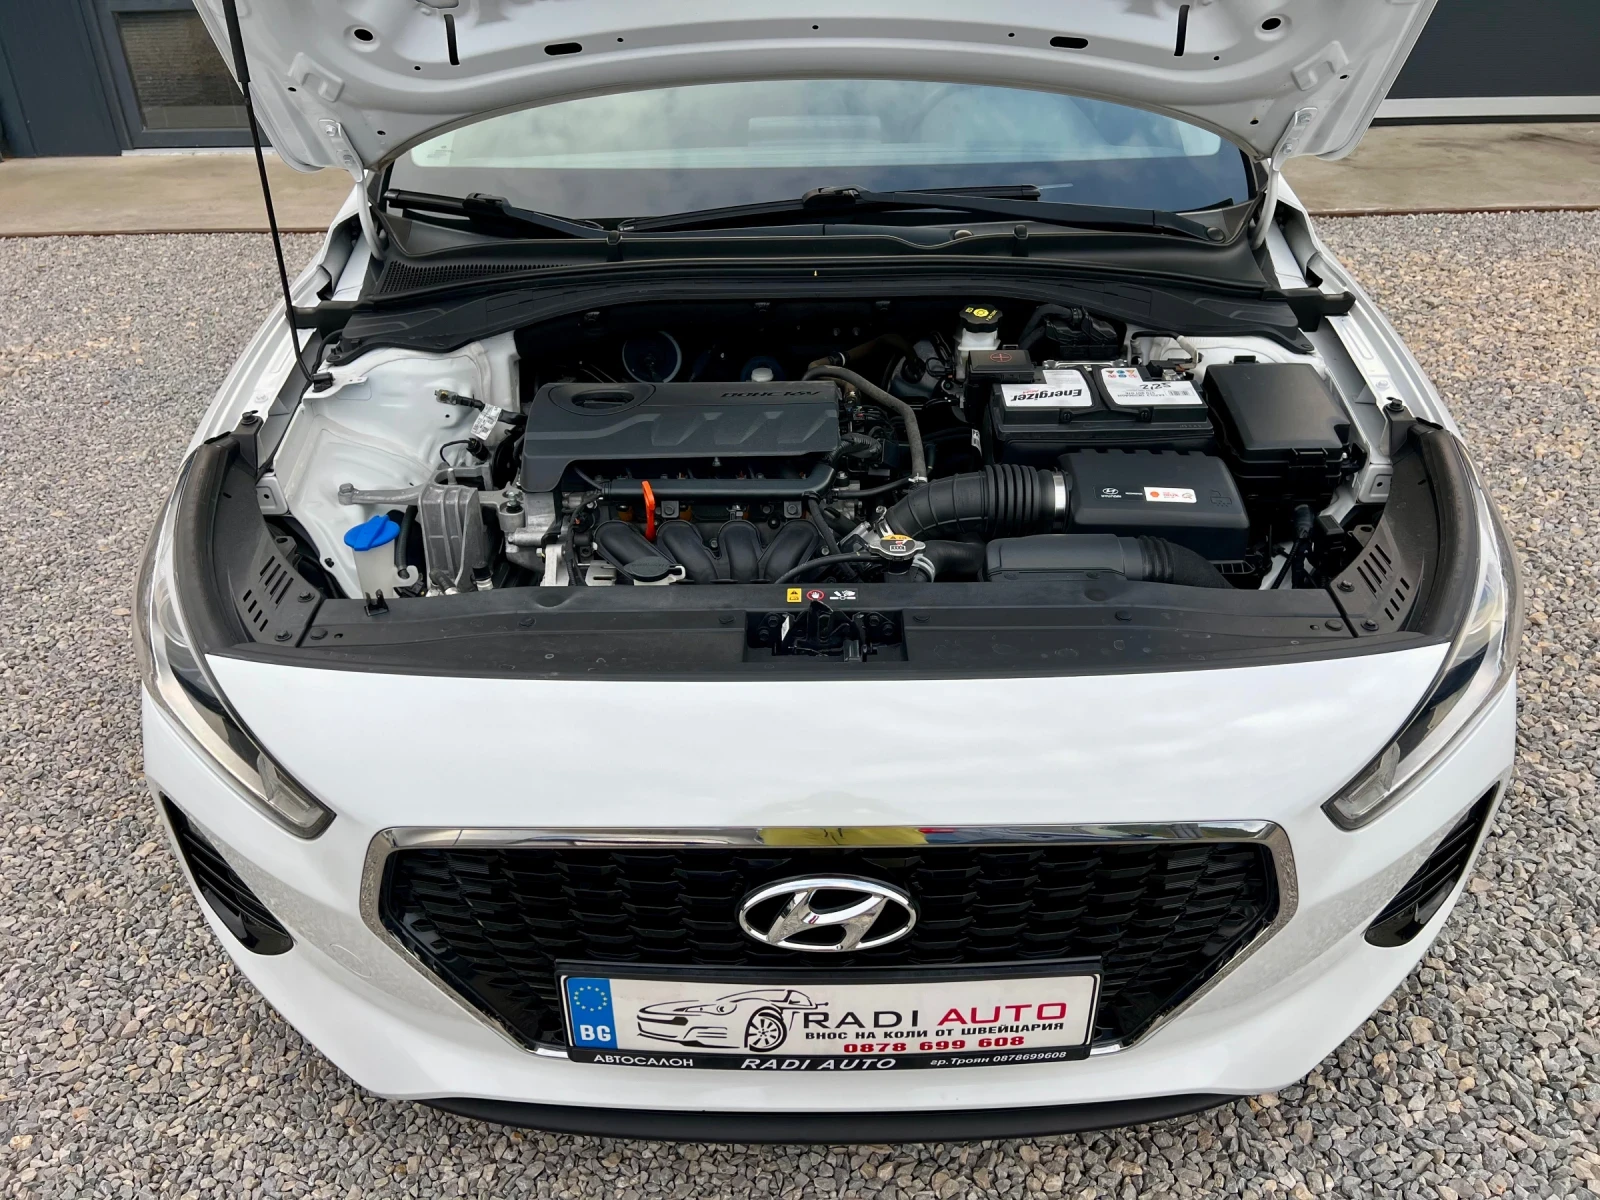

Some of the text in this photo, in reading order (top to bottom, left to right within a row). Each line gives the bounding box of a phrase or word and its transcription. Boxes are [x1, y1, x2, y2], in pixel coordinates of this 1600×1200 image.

[1010, 388, 1082, 402] Energizer
[803, 1002, 1067, 1029] RADI AUTO
[579, 1024, 612, 1042] BG
[806, 1022, 1064, 1040] ВНОС НА КОЛИ ОТ ШВЕЙЦАРИЯ
[844, 1036, 1025, 1054] 0878 699 608
[593, 1054, 695, 1068] АВТОСАЛОН
[740, 1057, 898, 1071] RADI AUTO
[992, 1051, 1067, 1063] 0878699608
